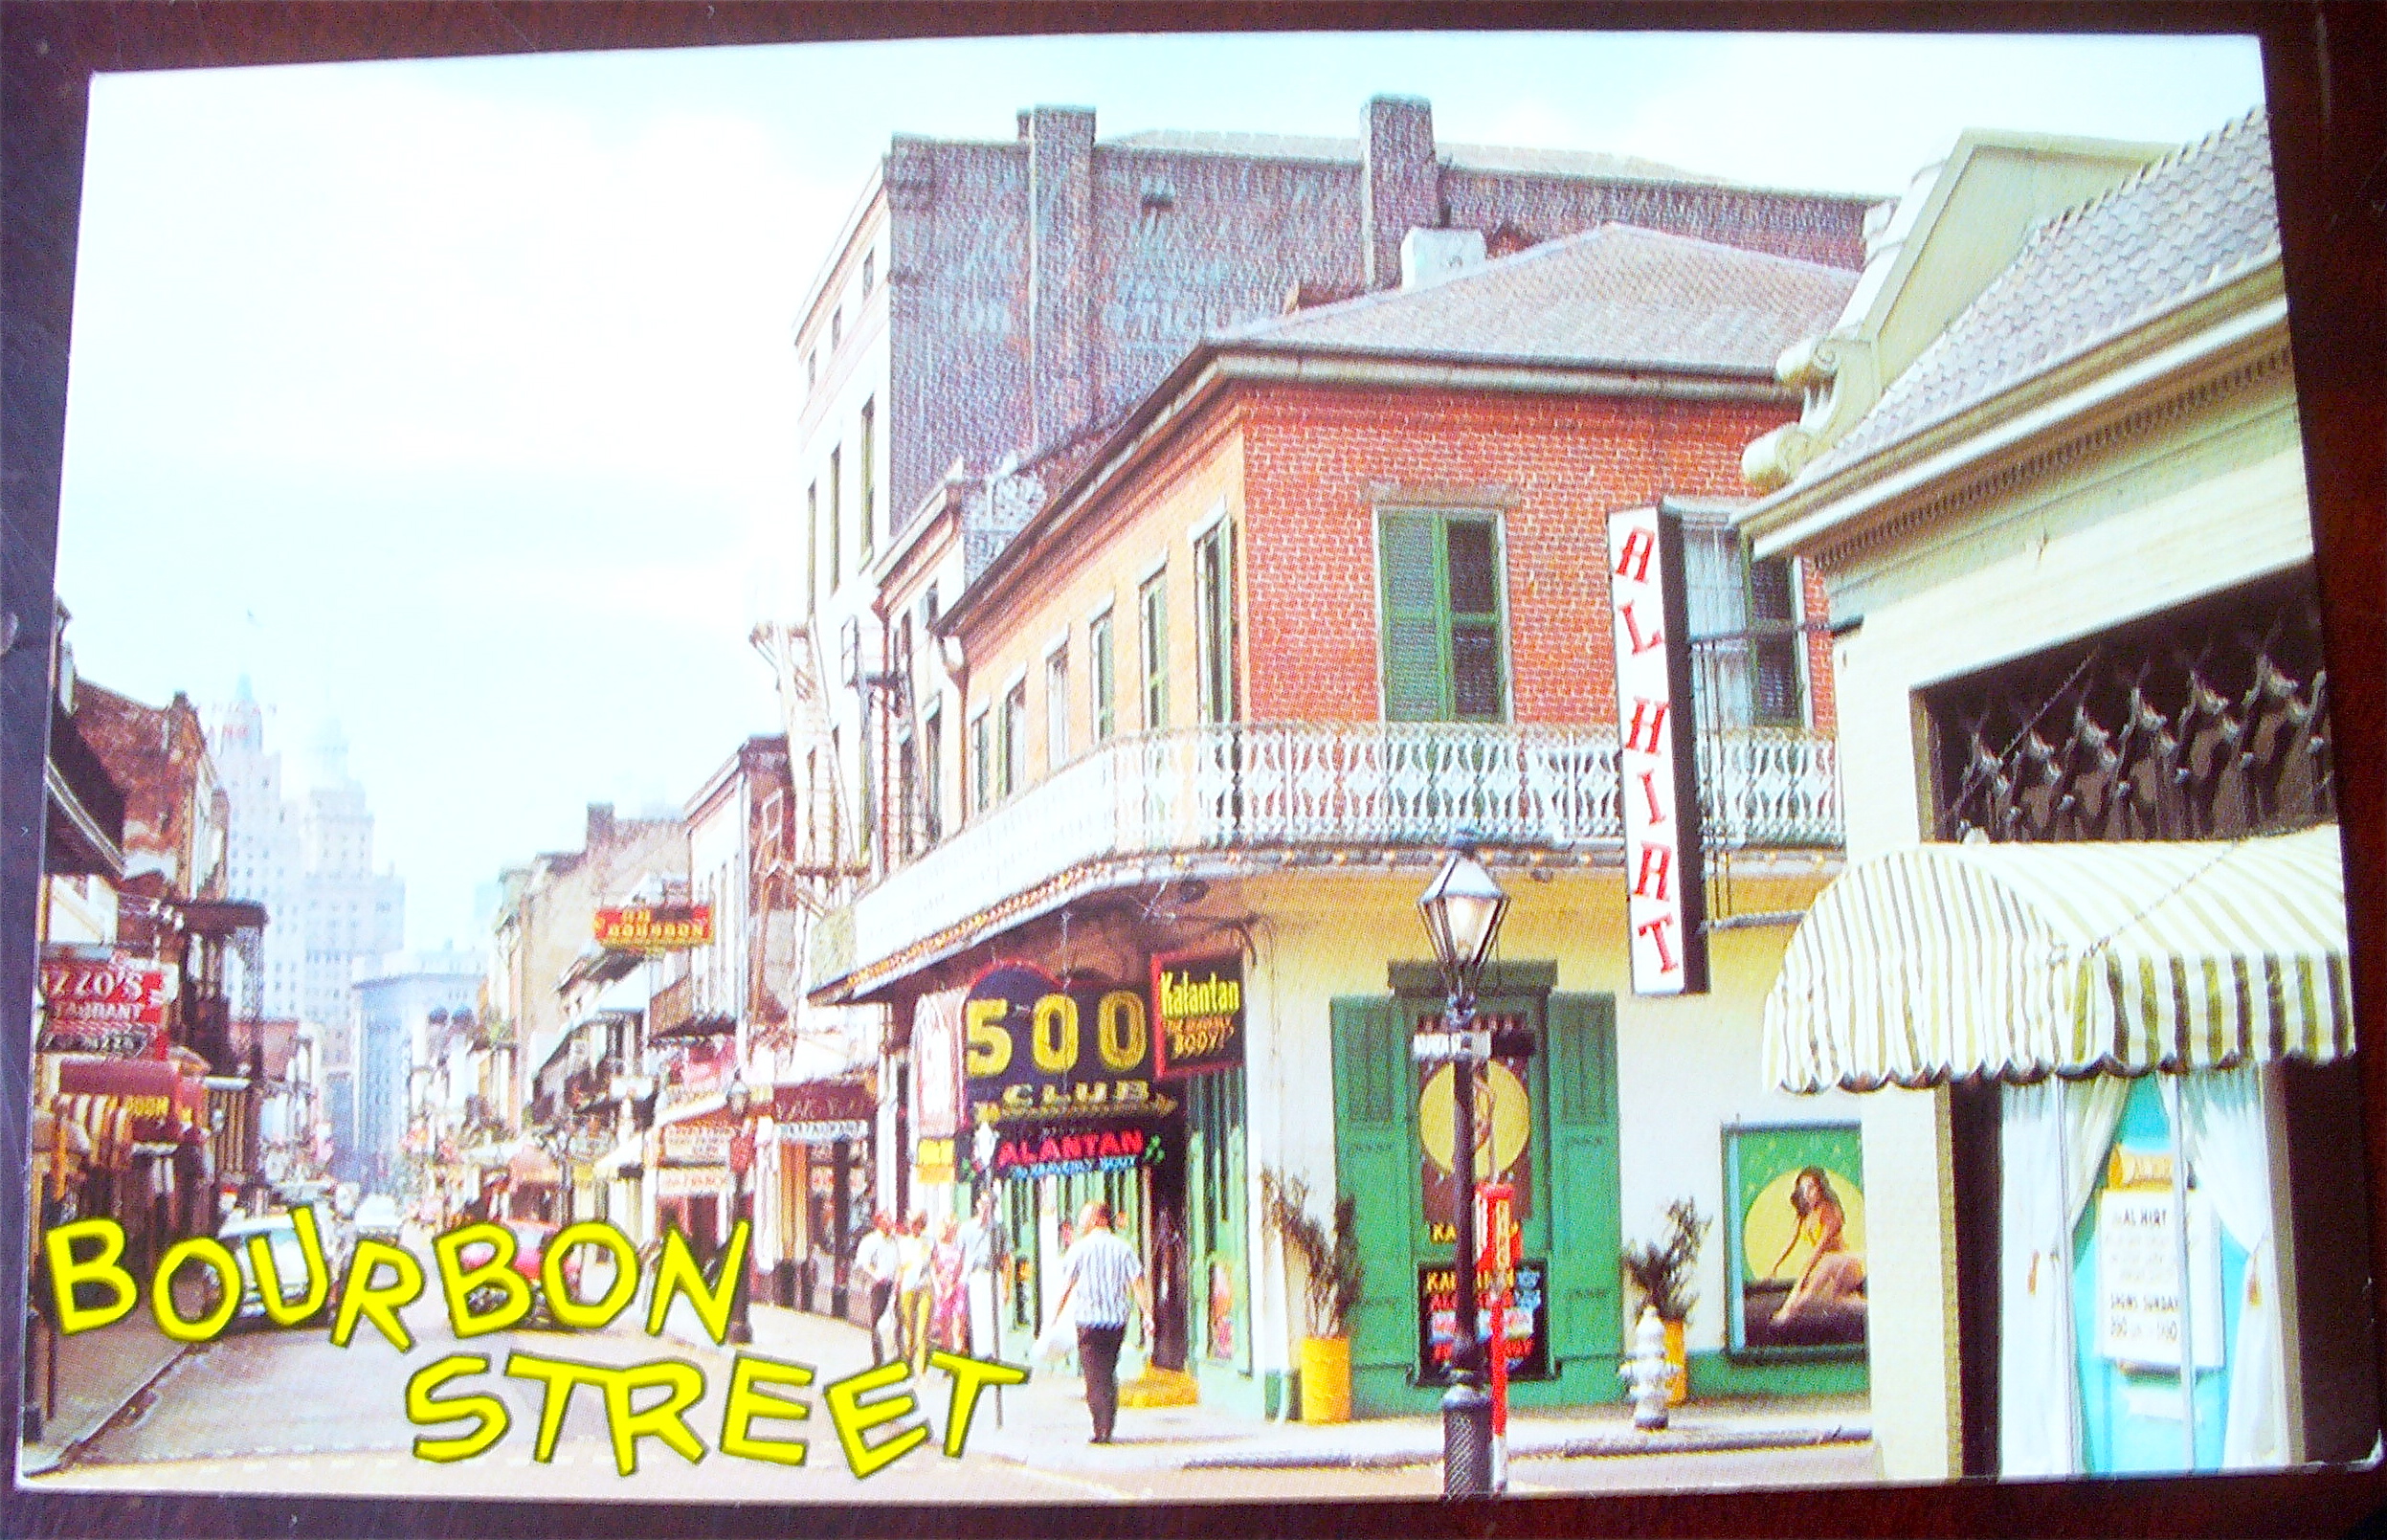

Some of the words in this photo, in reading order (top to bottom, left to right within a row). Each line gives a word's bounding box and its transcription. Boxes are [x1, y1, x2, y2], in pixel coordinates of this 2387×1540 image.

[1616, 526, 1662, 655] AL
[1624, 697, 1679, 974] HIRT
[1161, 970, 1239, 1017] Kalantan
[967, 990, 1148, 1077] 500
[1003, 1080, 1149, 1106] CLUB
[977, 1128, 1144, 1169] ALANTAN
